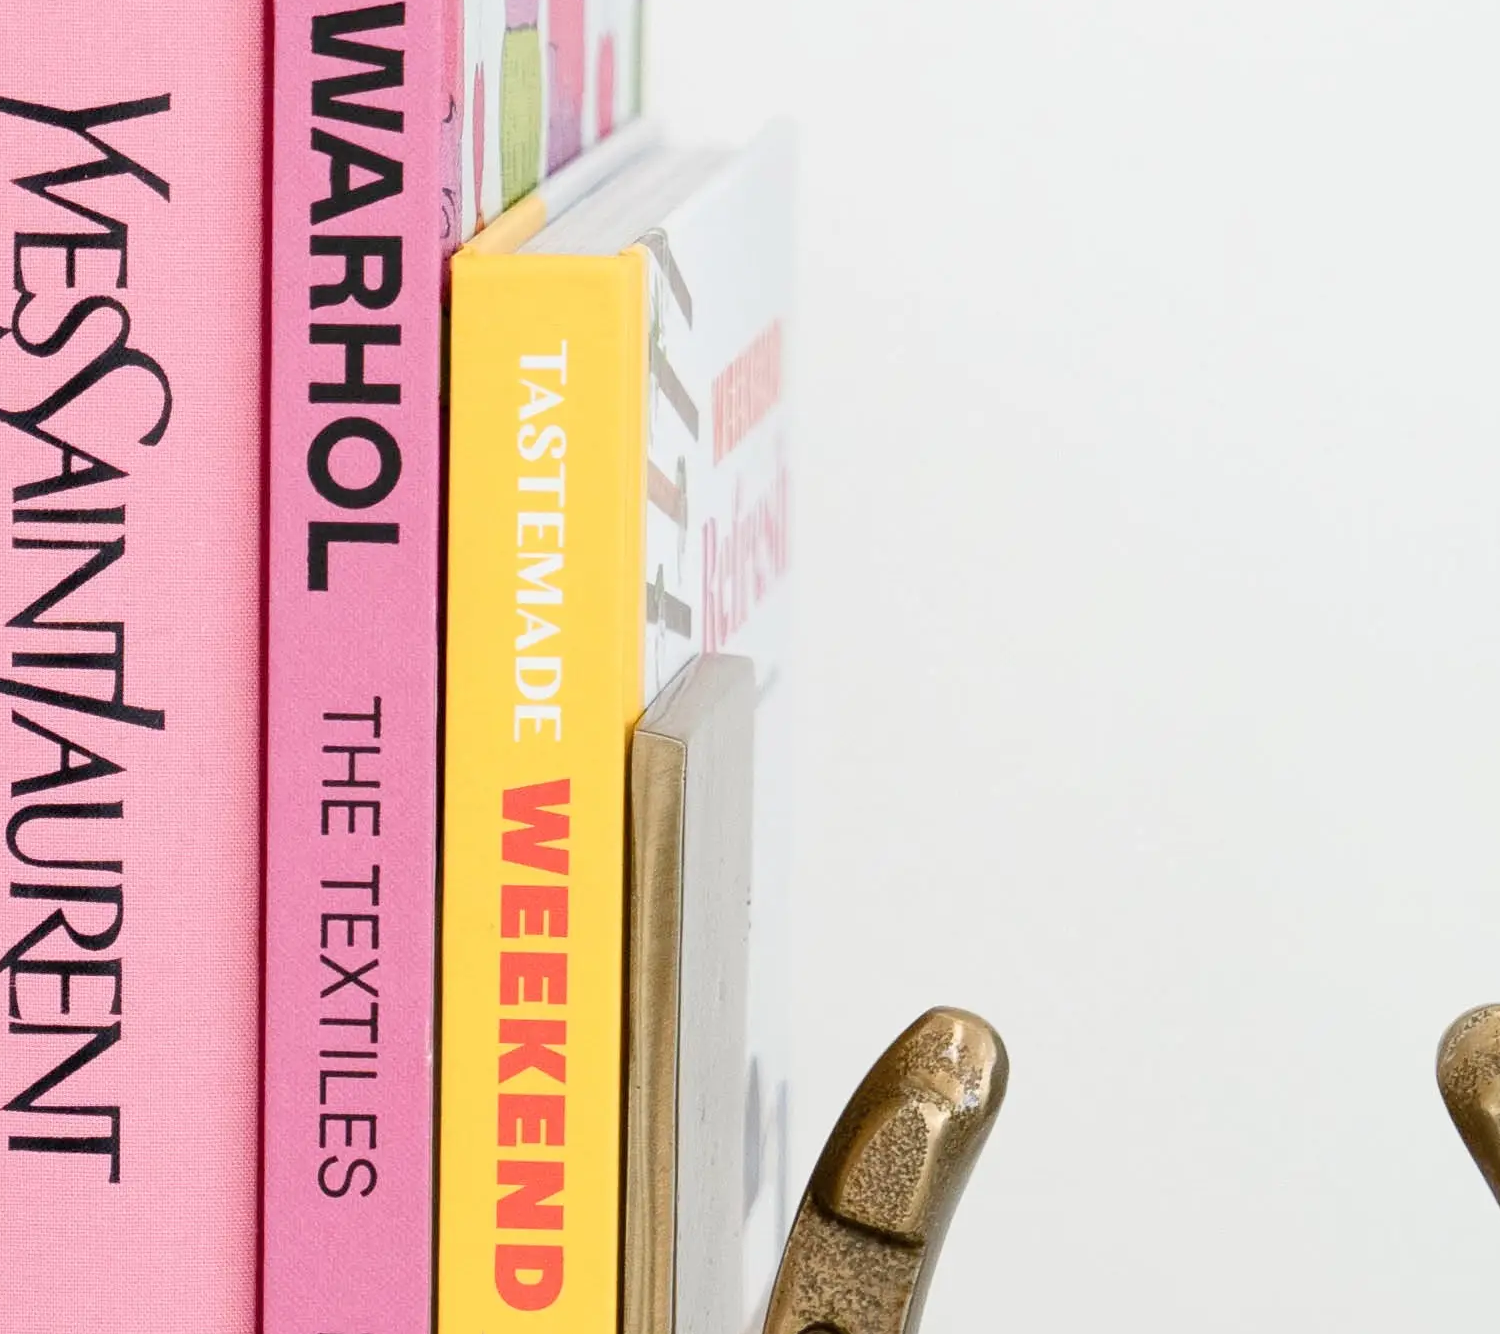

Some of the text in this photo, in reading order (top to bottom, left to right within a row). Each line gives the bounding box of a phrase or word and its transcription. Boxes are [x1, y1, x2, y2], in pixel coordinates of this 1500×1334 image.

[305, 0, 407, 593] WARHOL
[512, 338, 569, 743] TASTEMADE
[316, 695, 383, 1200] THE TEXTILES
[493, 777, 572, 1312] WEEKEND
